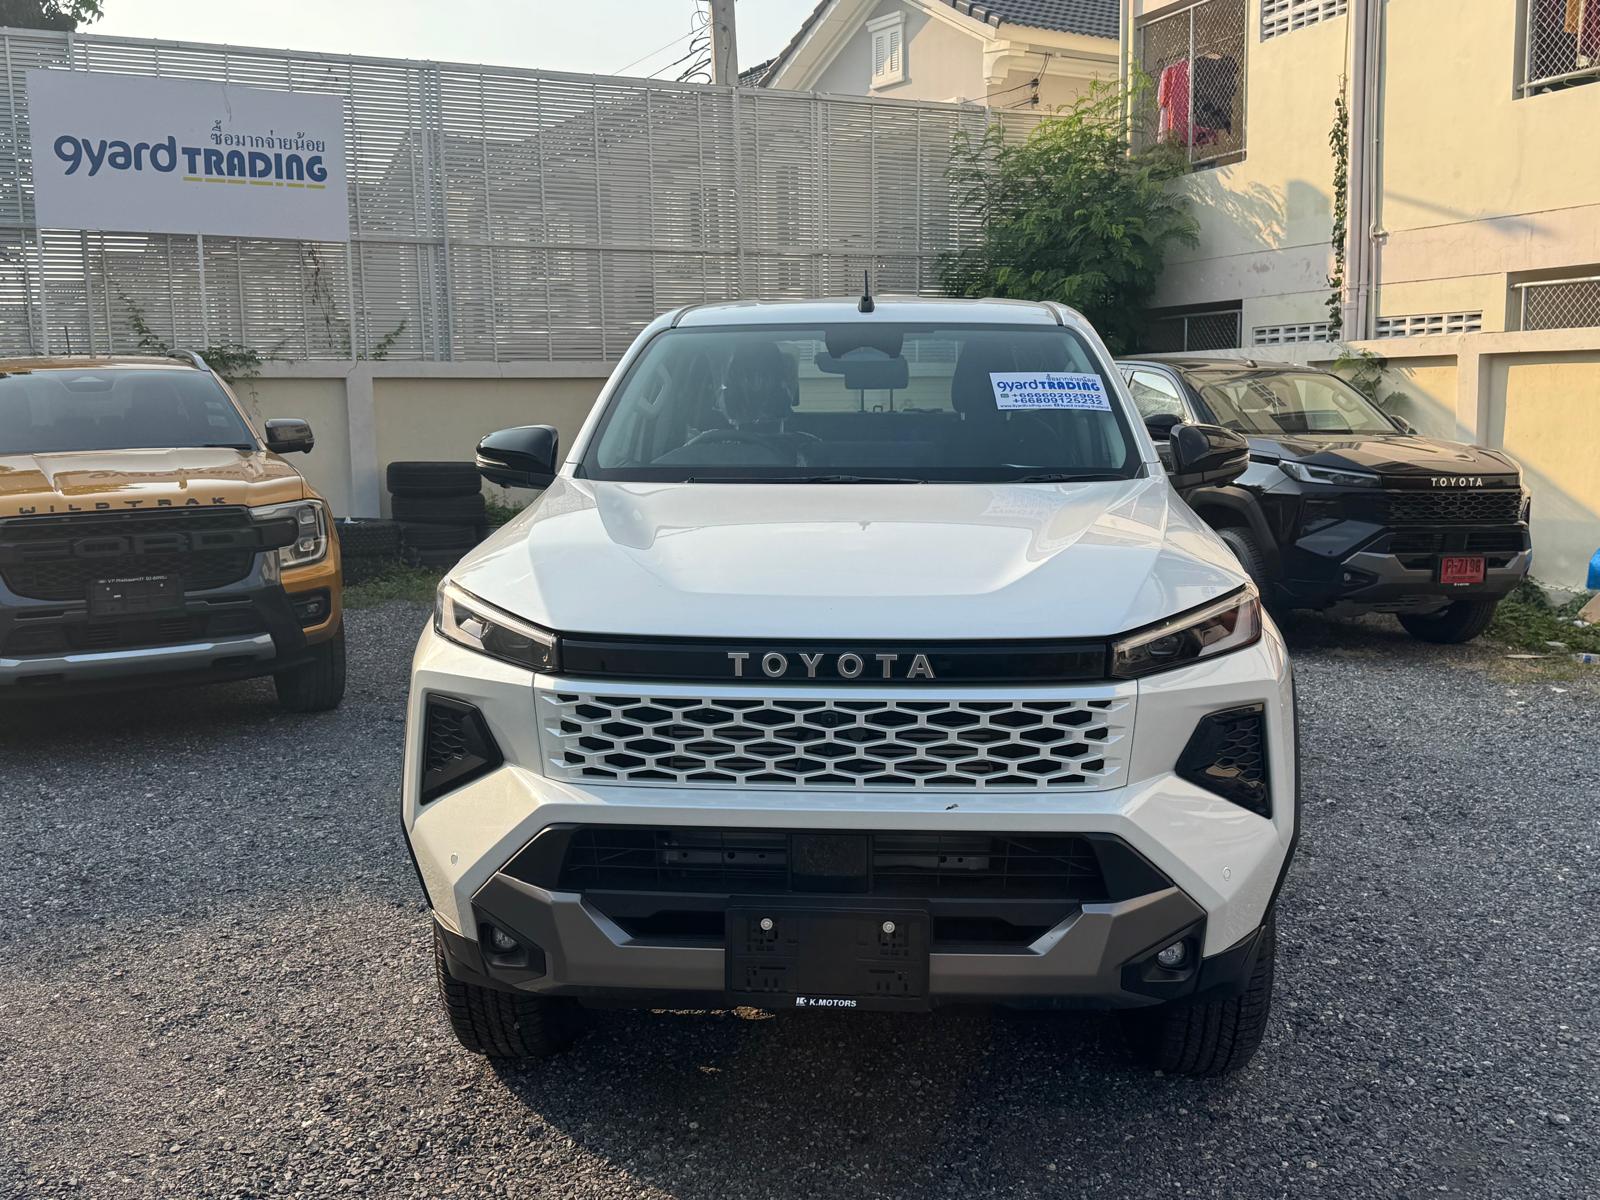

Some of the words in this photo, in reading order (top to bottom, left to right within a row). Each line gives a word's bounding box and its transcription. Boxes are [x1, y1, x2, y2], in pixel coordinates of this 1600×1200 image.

[210, 119, 326, 153] ซื้อมากจ่ายน้อย
[54, 134, 178, 177] 9yard
[181, 147, 328, 182] TRADING
[1038, 381, 1100, 391] TRADING
[1431, 477, 1483, 487] TOYOTA
[19, 497, 226, 514] WILDTRAK
[727, 652, 936, 679] TOYOTA
[809, 998, 857, 1007] K.MOTORS
